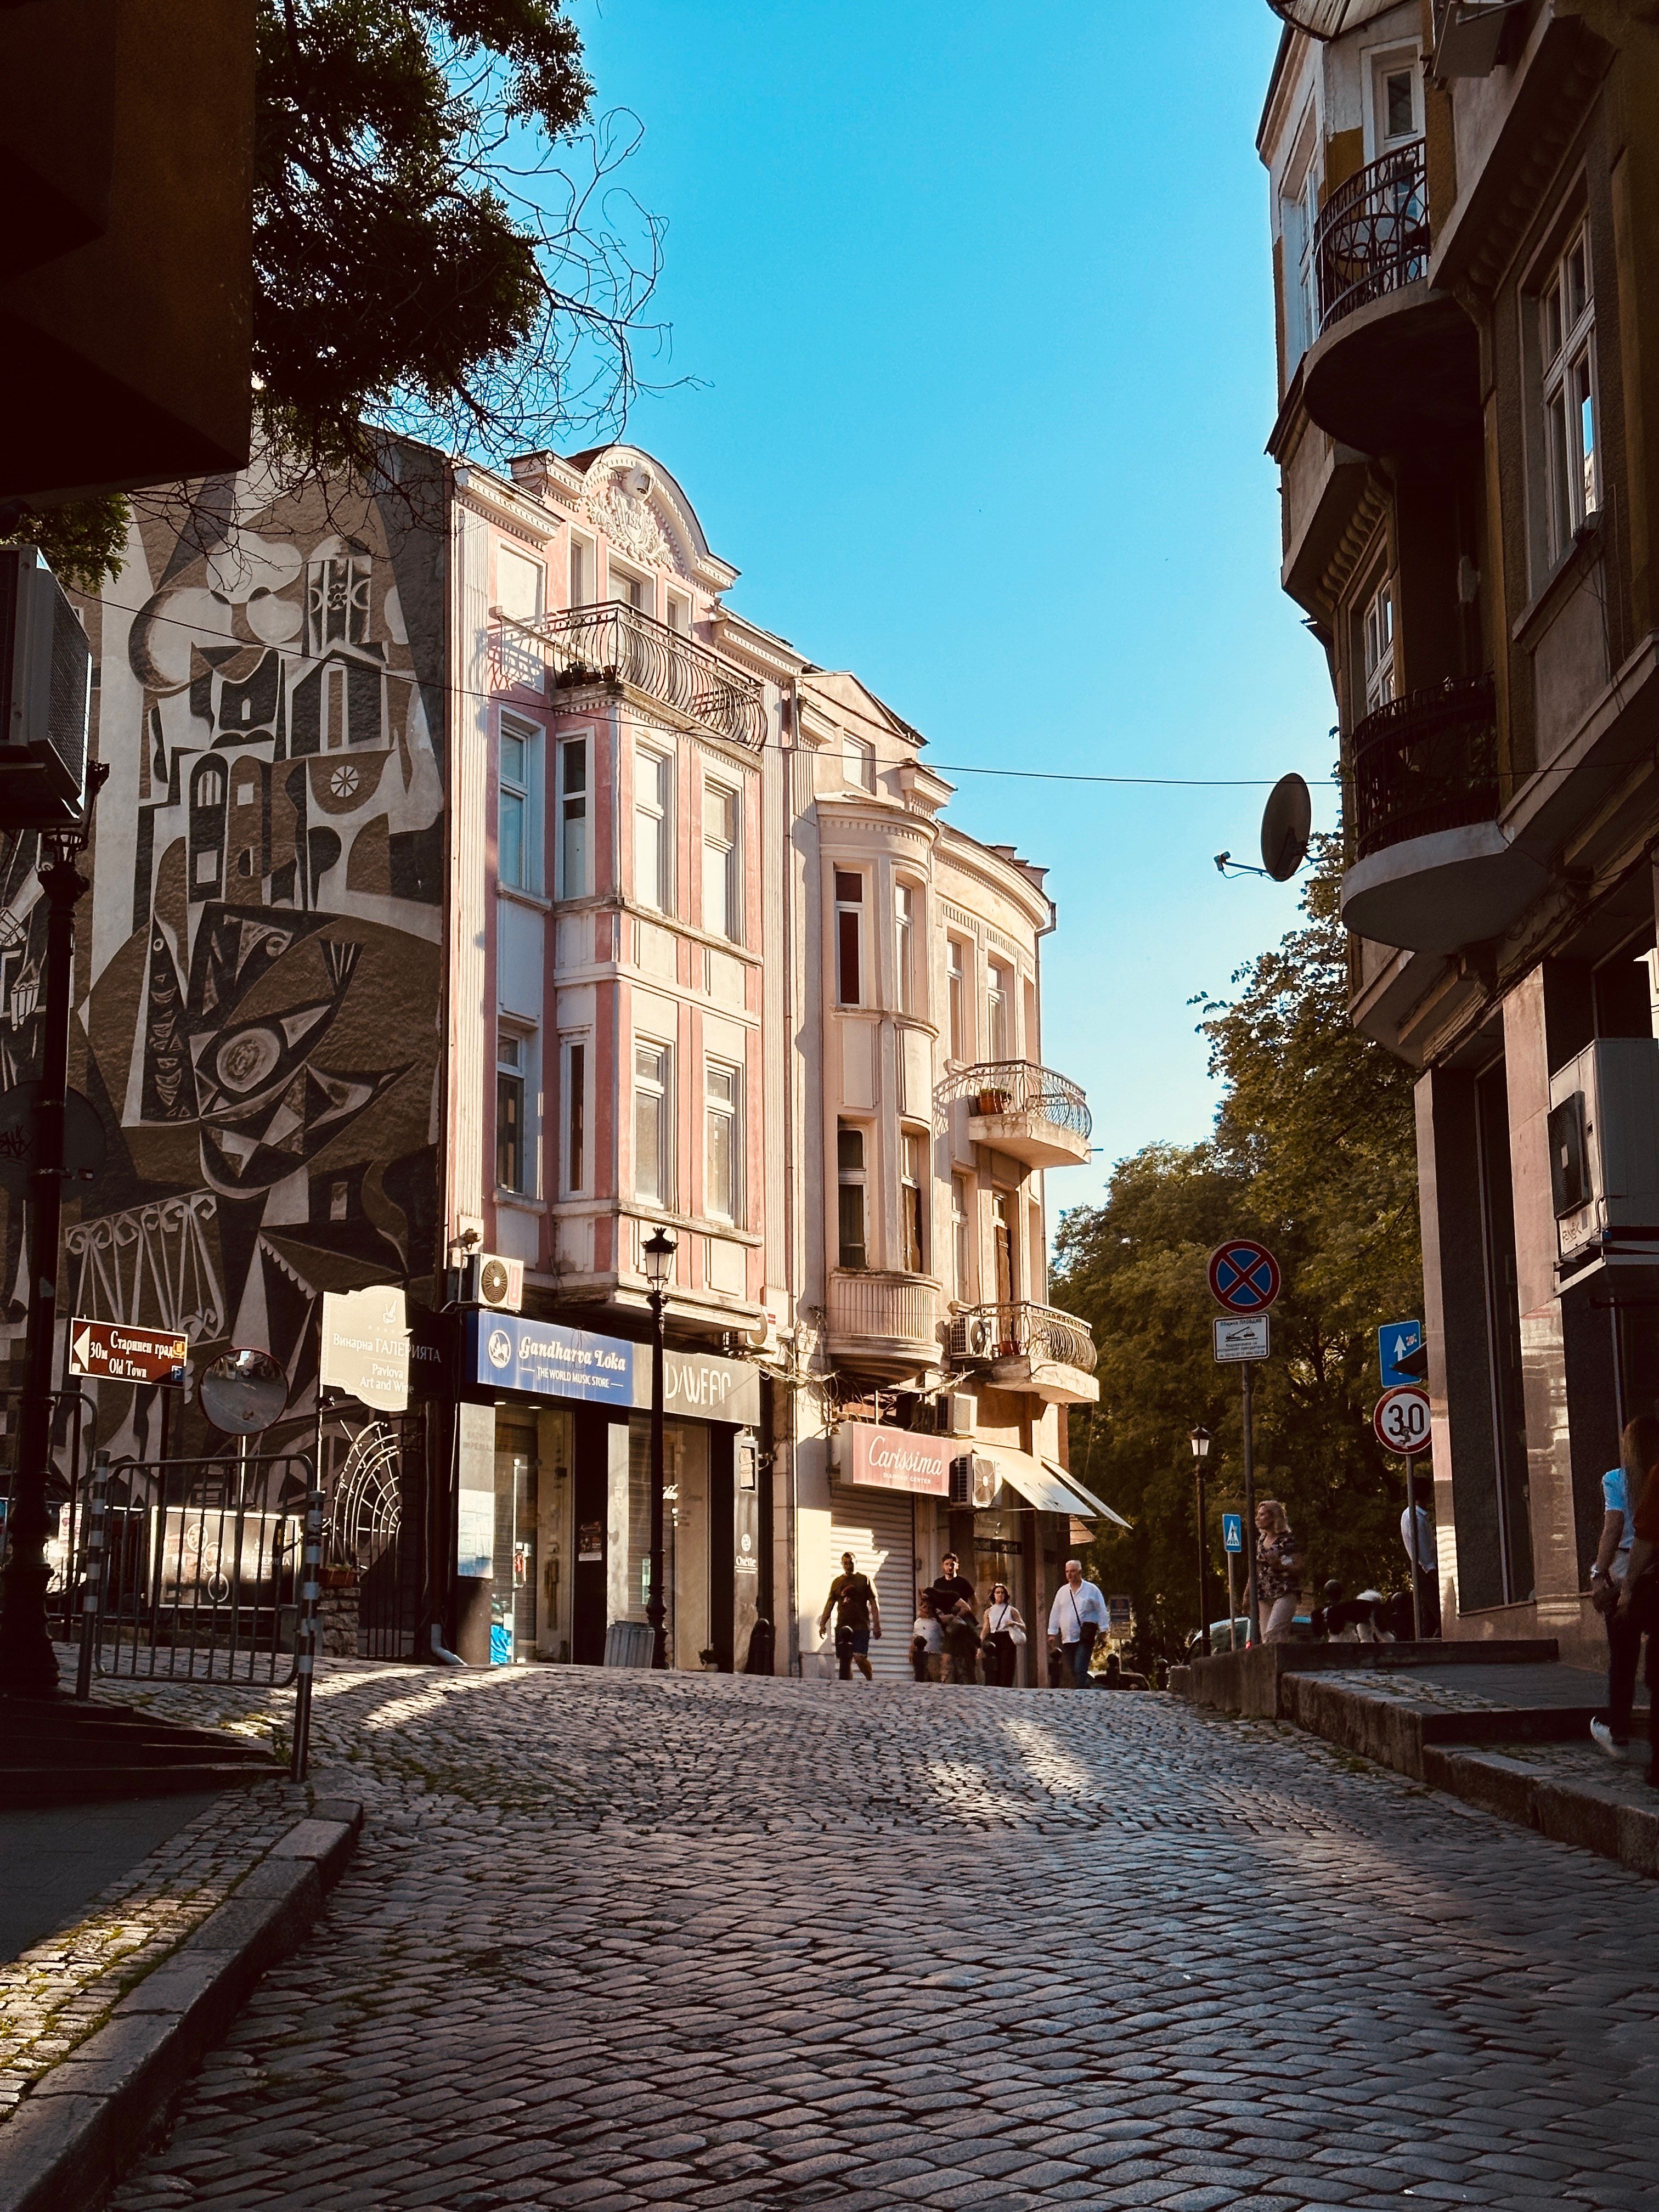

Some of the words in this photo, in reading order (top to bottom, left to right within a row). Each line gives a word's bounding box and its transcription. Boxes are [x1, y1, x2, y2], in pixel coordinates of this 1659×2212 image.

[155, 1342, 174, 1359] град
[332, 1333, 373, 1352] Винарна
[375, 1338, 442, 1363] ГАЛЕРИЯТА
[518, 1336, 592, 1365] Gandharva
[594, 1350, 626, 1372] Loka
[109, 1358, 124, 1374] Old
[126, 1359, 147, 1378] Town
[372, 1363, 404, 1380] Pavlova
[537, 1366, 549, 1379] THE
[549, 1369, 571, 1382] WORLD
[572, 1373, 591, 1385] MUSIC
[591, 1376, 610, 1389] STORE
[360, 1376, 374, 1390] Art
[376, 1379, 391, 1392] and
[393, 1380, 414, 1395] Wine
[1389, 1404, 1424, 1436] 30
[868, 1435, 943, 1475] Carissima
[910, 1476, 932, 1485] CENTER
